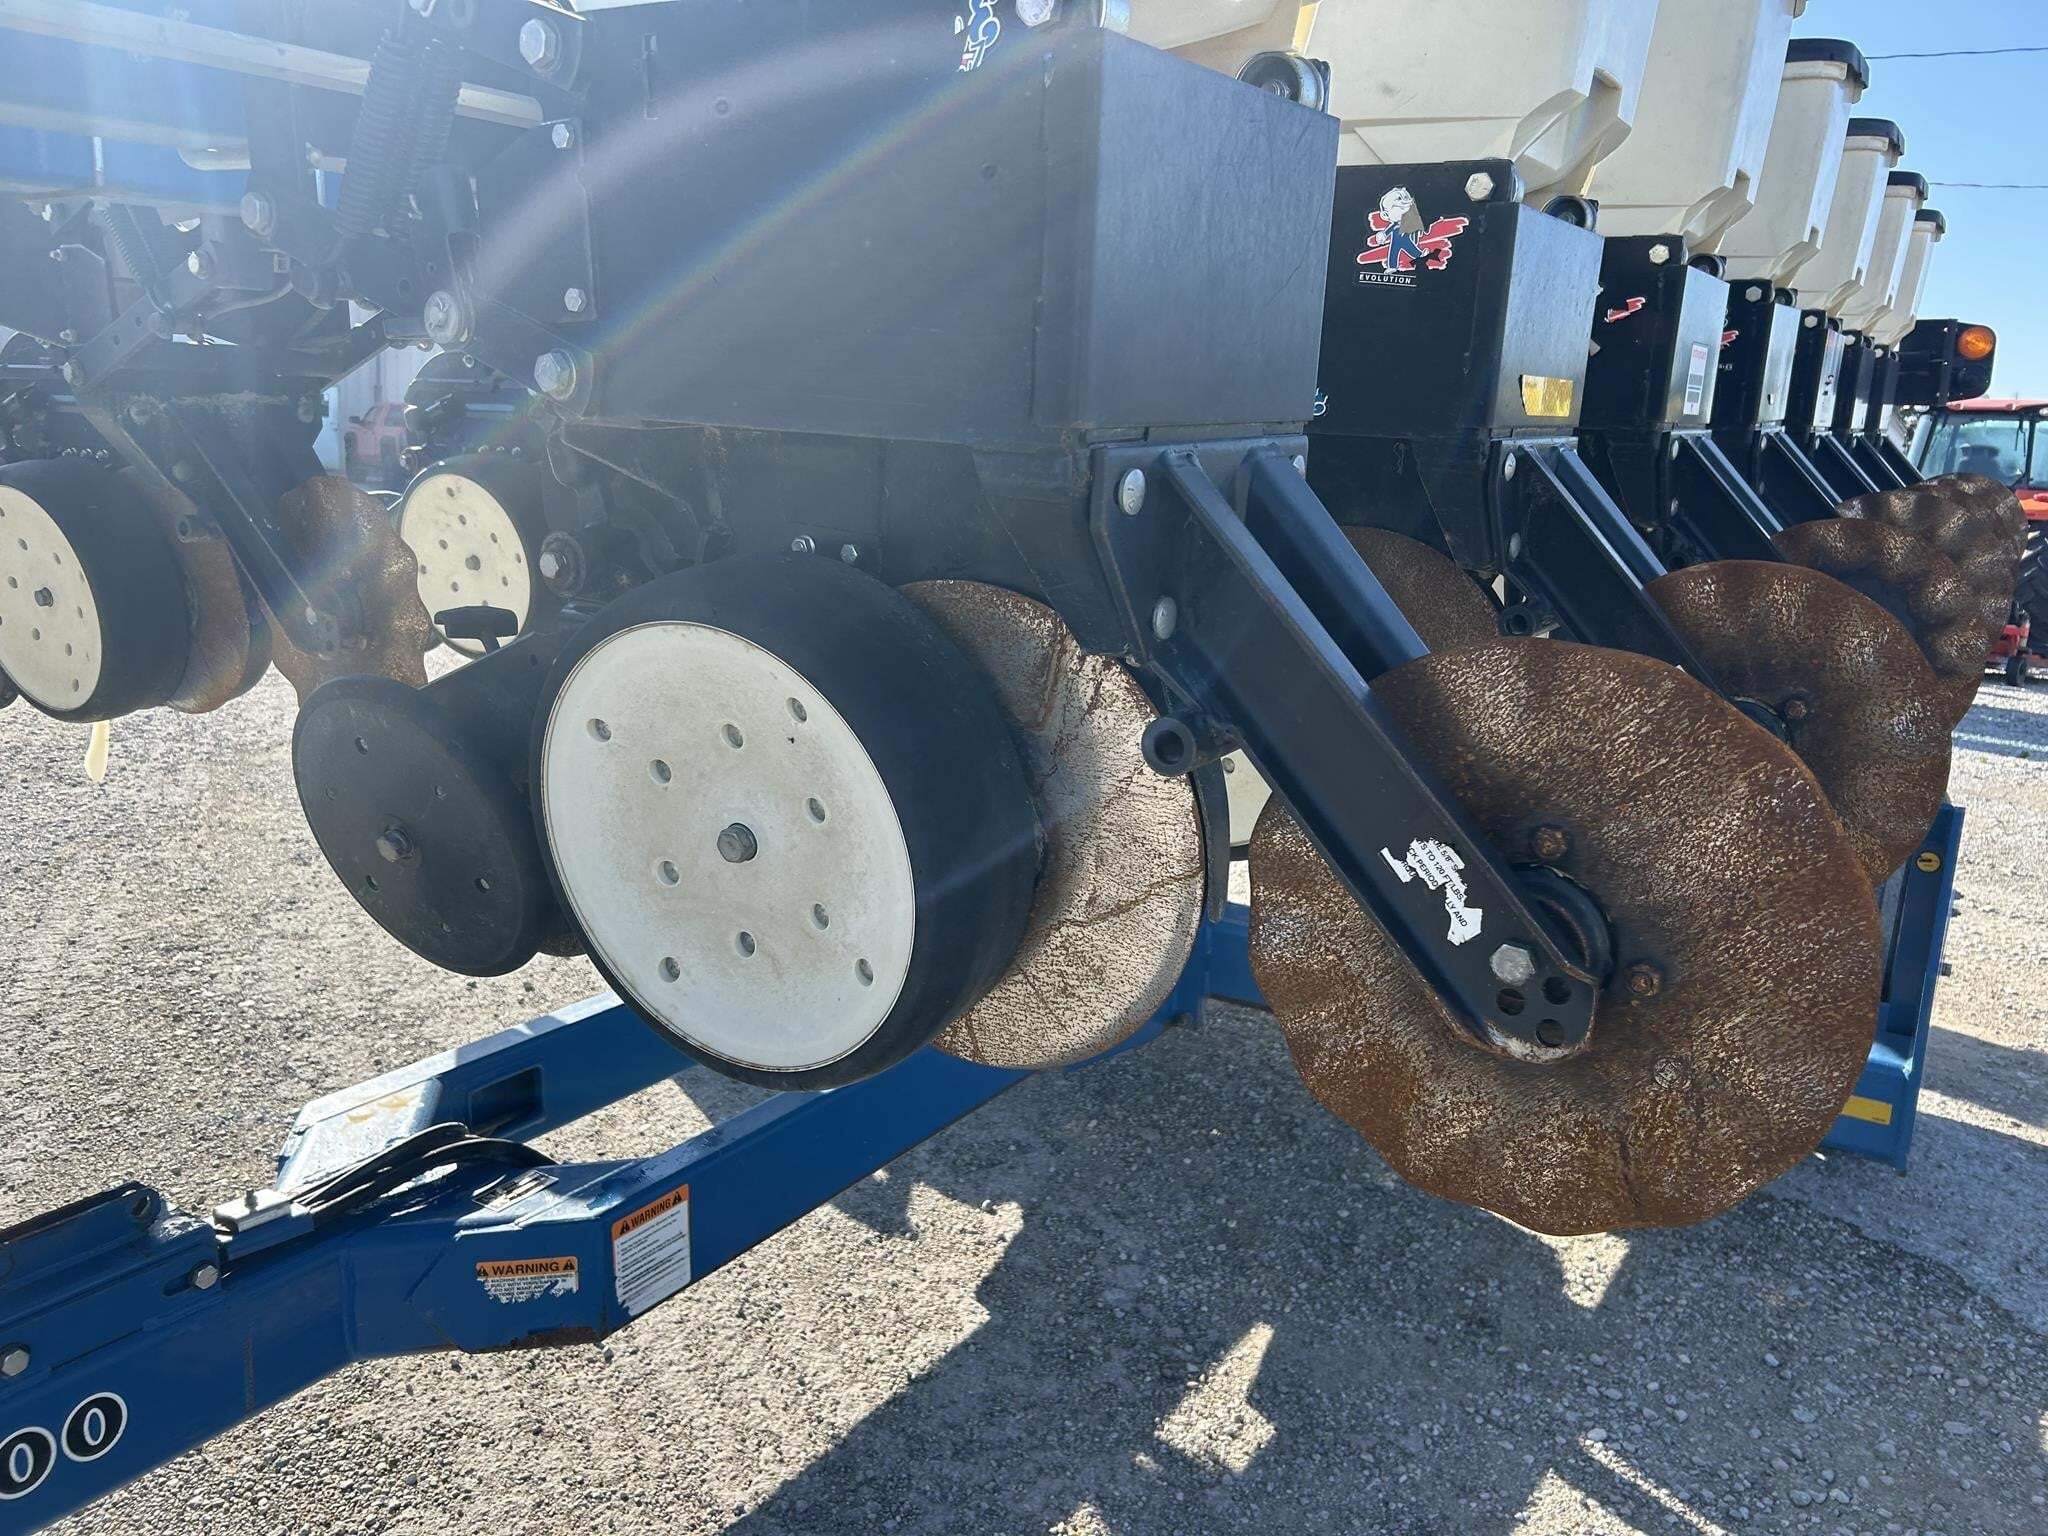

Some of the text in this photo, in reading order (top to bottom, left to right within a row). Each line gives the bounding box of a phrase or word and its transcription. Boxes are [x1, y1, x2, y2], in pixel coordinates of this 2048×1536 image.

[1359, 274, 1411, 284] EVOLUTION
[1426, 850, 1436, 861] TO
[1434, 862, 1445, 875] 120
[1407, 846, 1419, 859] CK
[1453, 911, 1468, 927] AND
[630, 1198, 672, 1228] WARNING
[492, 1262, 559, 1275] WARNING
